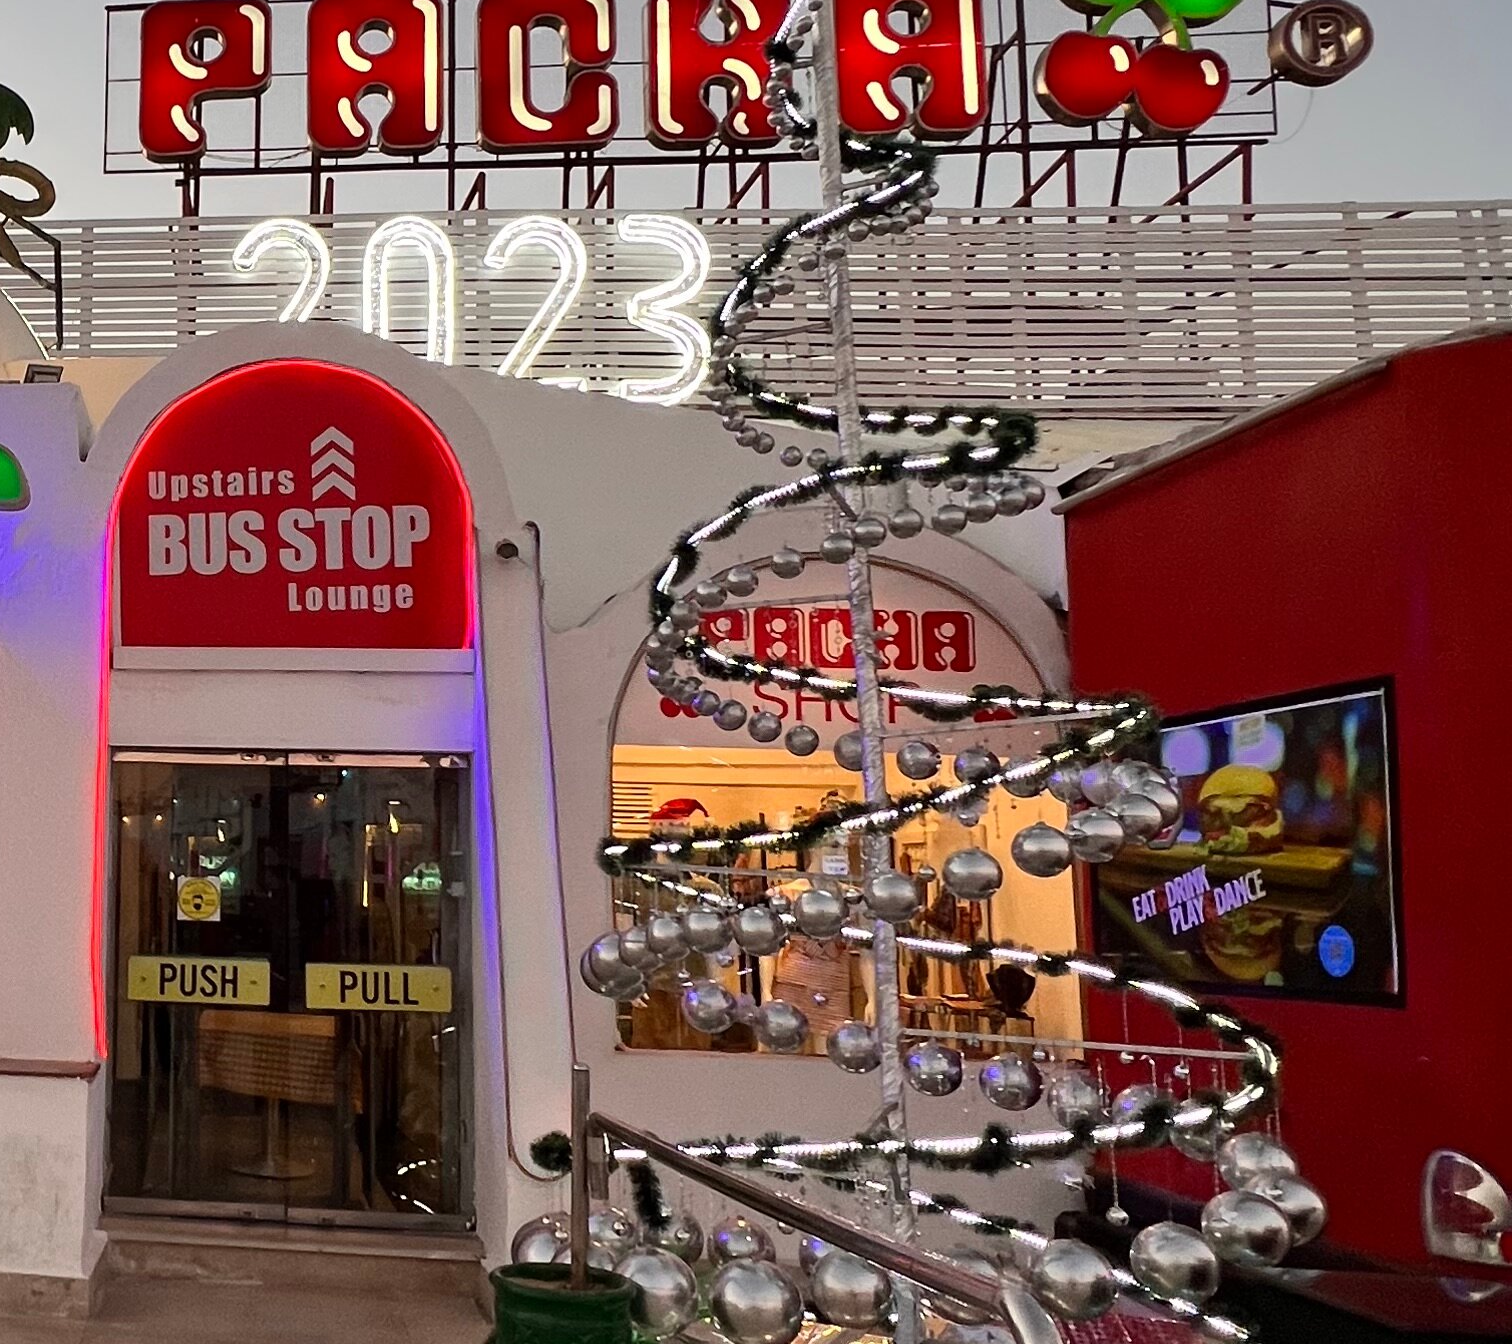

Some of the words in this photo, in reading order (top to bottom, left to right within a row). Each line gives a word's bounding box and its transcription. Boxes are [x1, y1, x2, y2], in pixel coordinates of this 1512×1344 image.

[232, 214, 712, 407] 2023
[148, 467, 295, 502] Upstairs
[148, 510, 267, 576] BUS
[277, 505, 431, 573] STOP
[287, 582, 415, 613] Lounge
[1131, 889, 1158, 923] EAT
[1164, 864, 1211, 908] DRINK
[1169, 893, 1206, 936] PLAY
[1213, 868, 1267, 916] DANCE
[158, 961, 240, 999] PUSH
[339, 969, 419, 1006] PULL
